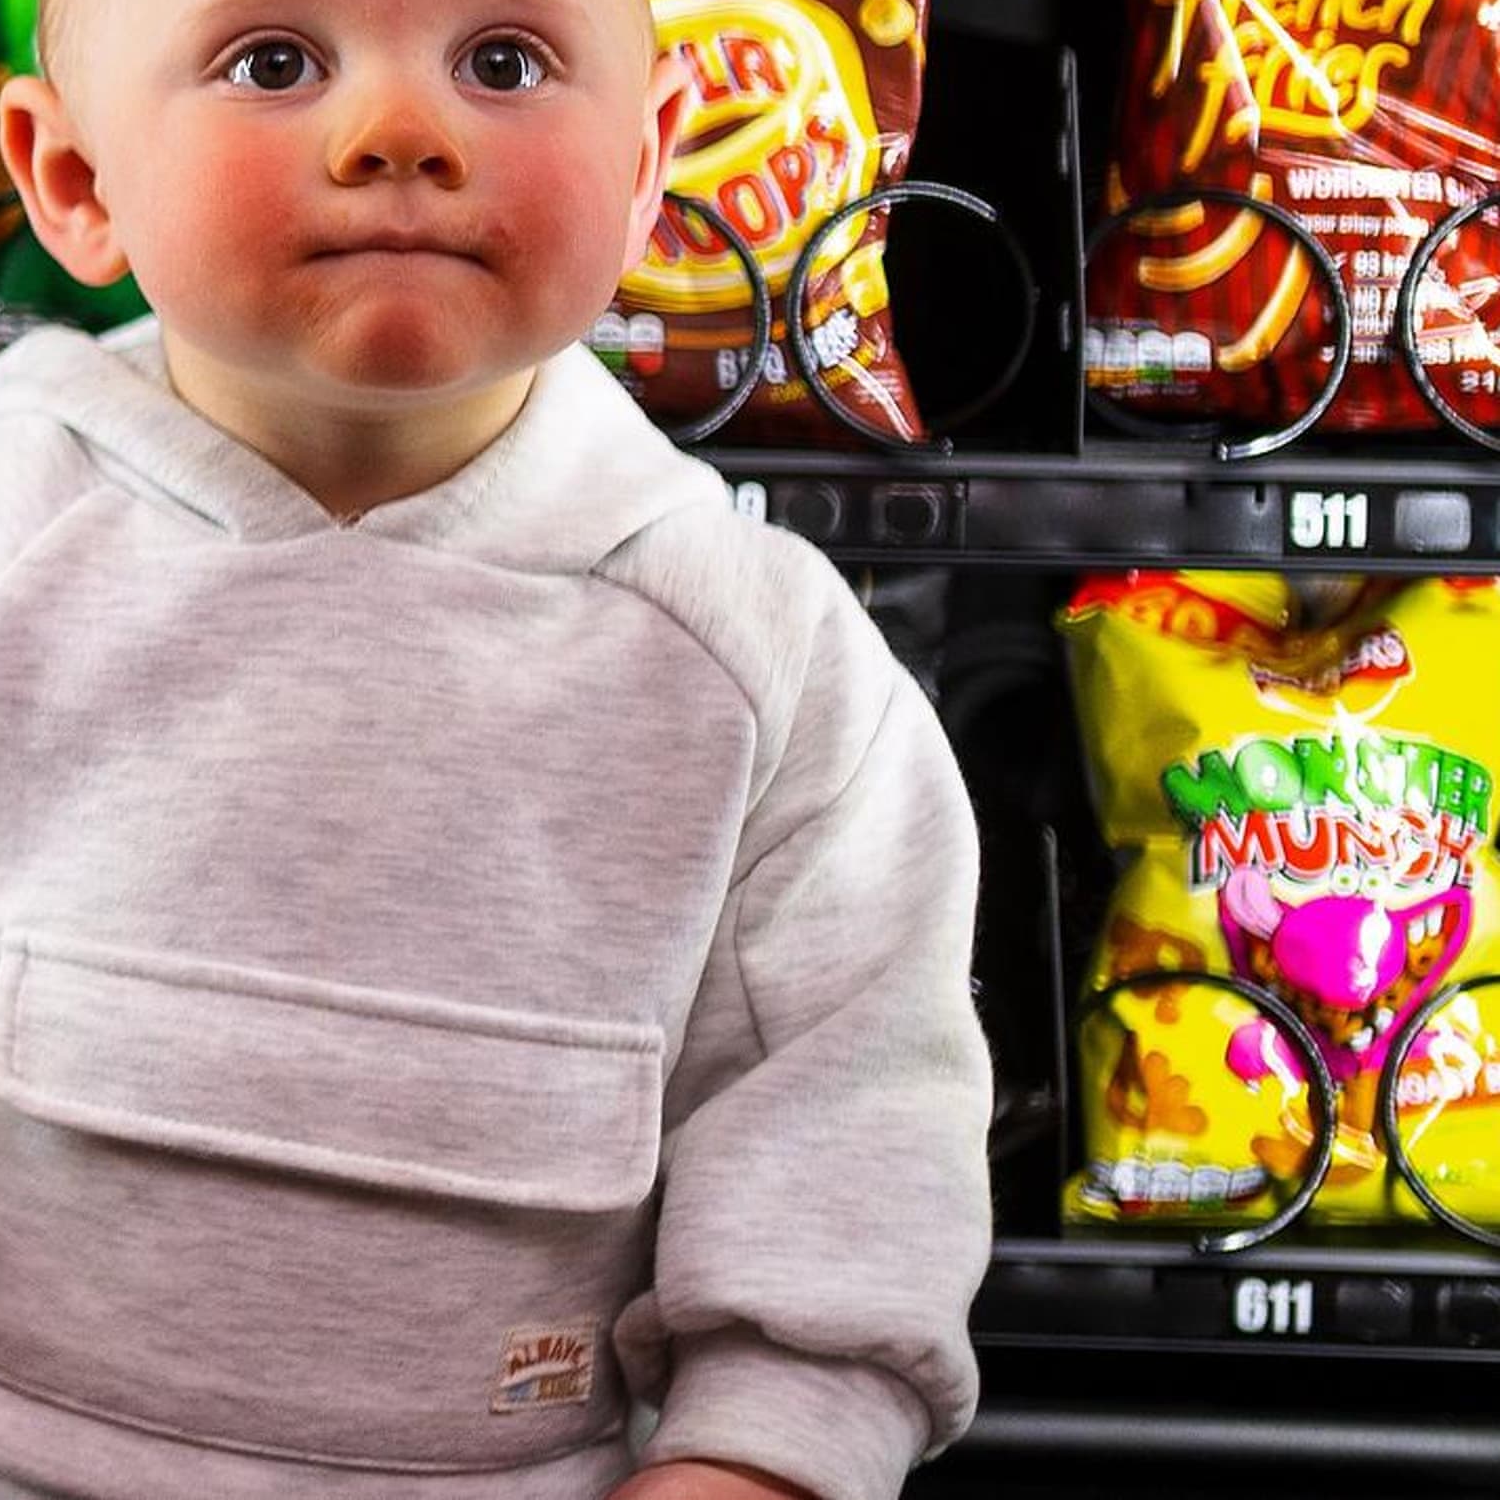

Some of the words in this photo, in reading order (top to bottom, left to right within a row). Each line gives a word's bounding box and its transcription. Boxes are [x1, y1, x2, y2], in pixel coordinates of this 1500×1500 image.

[1290, 492, 1369, 548] 511
[1162, 730, 1493, 836] MONSTER
[1189, 808, 1477, 890] MUNCH
[1235, 1277, 1313, 1334] 611
